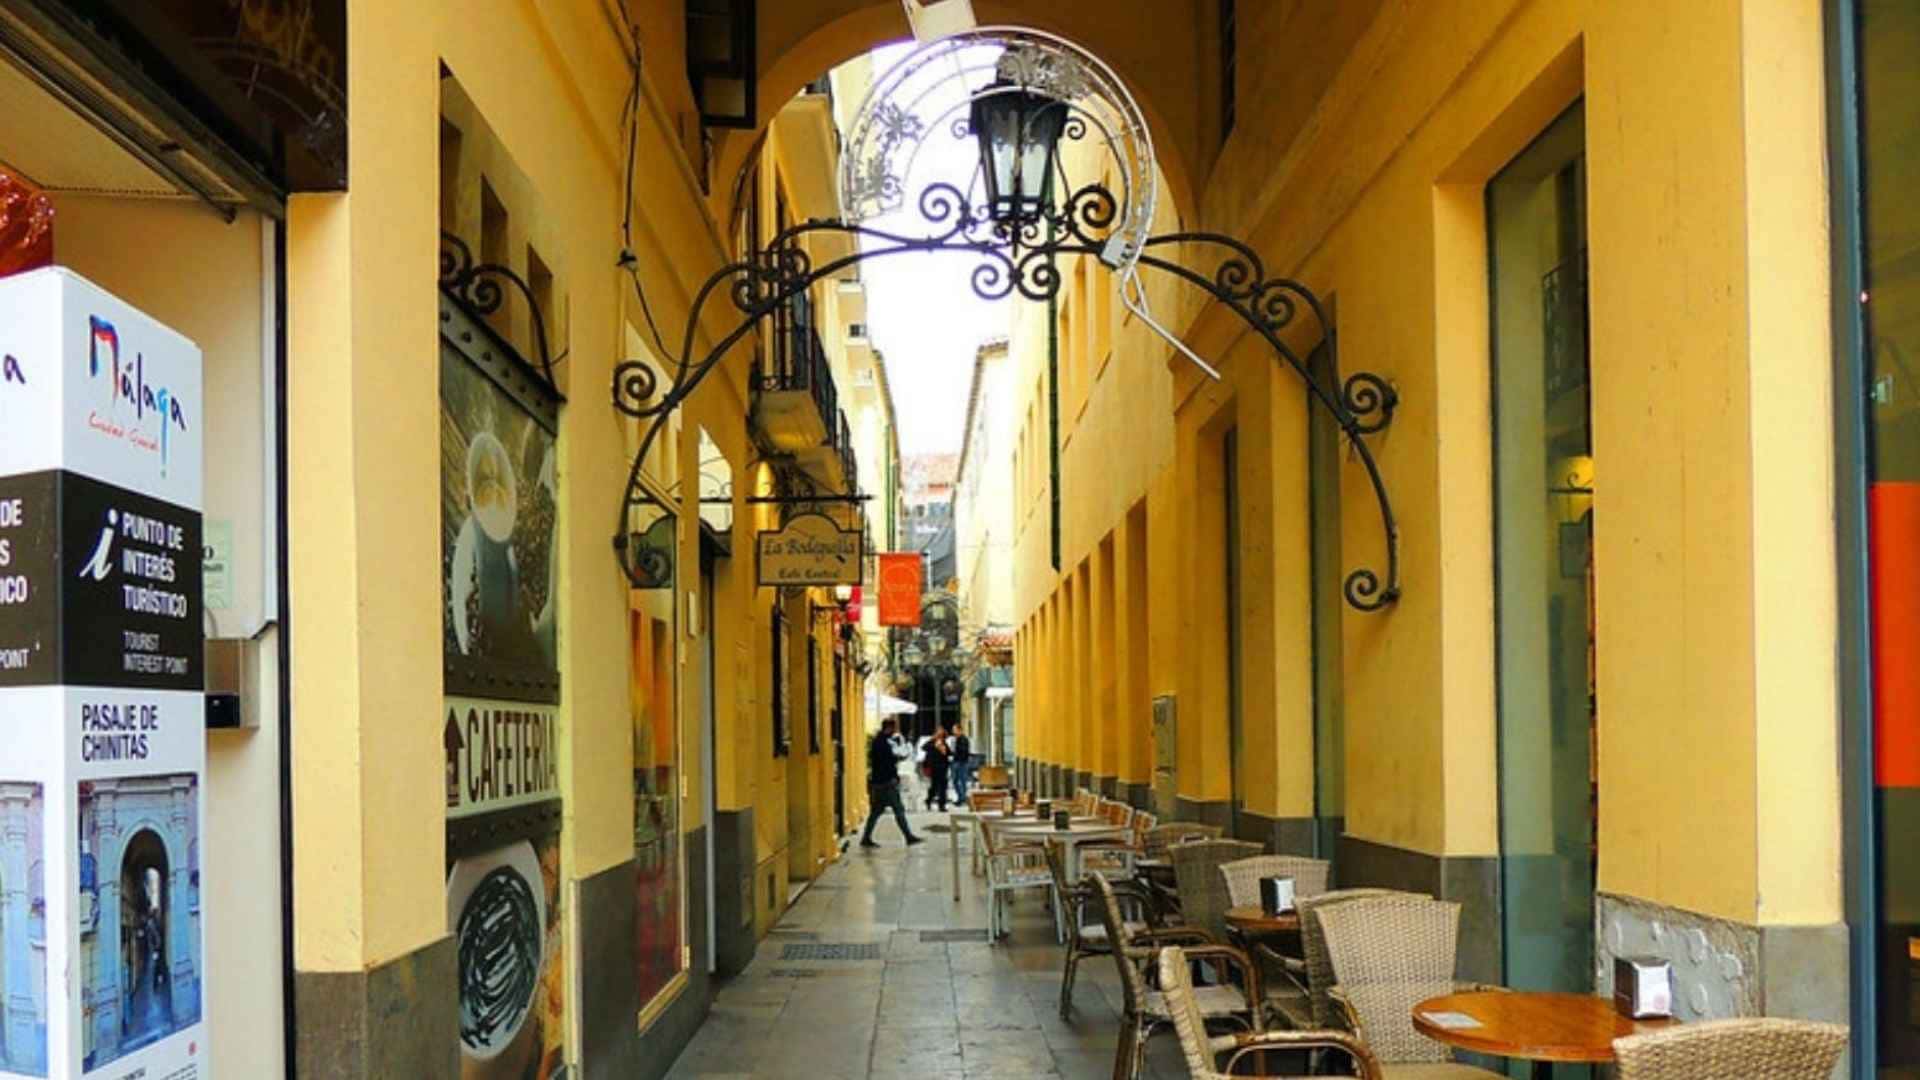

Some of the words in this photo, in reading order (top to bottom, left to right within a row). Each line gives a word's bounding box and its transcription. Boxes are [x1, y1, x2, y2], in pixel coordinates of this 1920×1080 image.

[122, 512, 165, 546] PUNTO
[167, 524, 184, 551] DE
[122, 547, 176, 582] INTERÉS
[122, 583, 188, 618] TURÍSTICO
[123, 630, 161, 651] TOURIST
[123, 653, 164, 674] INTEREST
[165, 656, 188, 675] POINT
[82, 703, 137, 731] PASAJE
[140, 704, 158, 730] DE
[82, 732, 149, 762] CHINITAS
